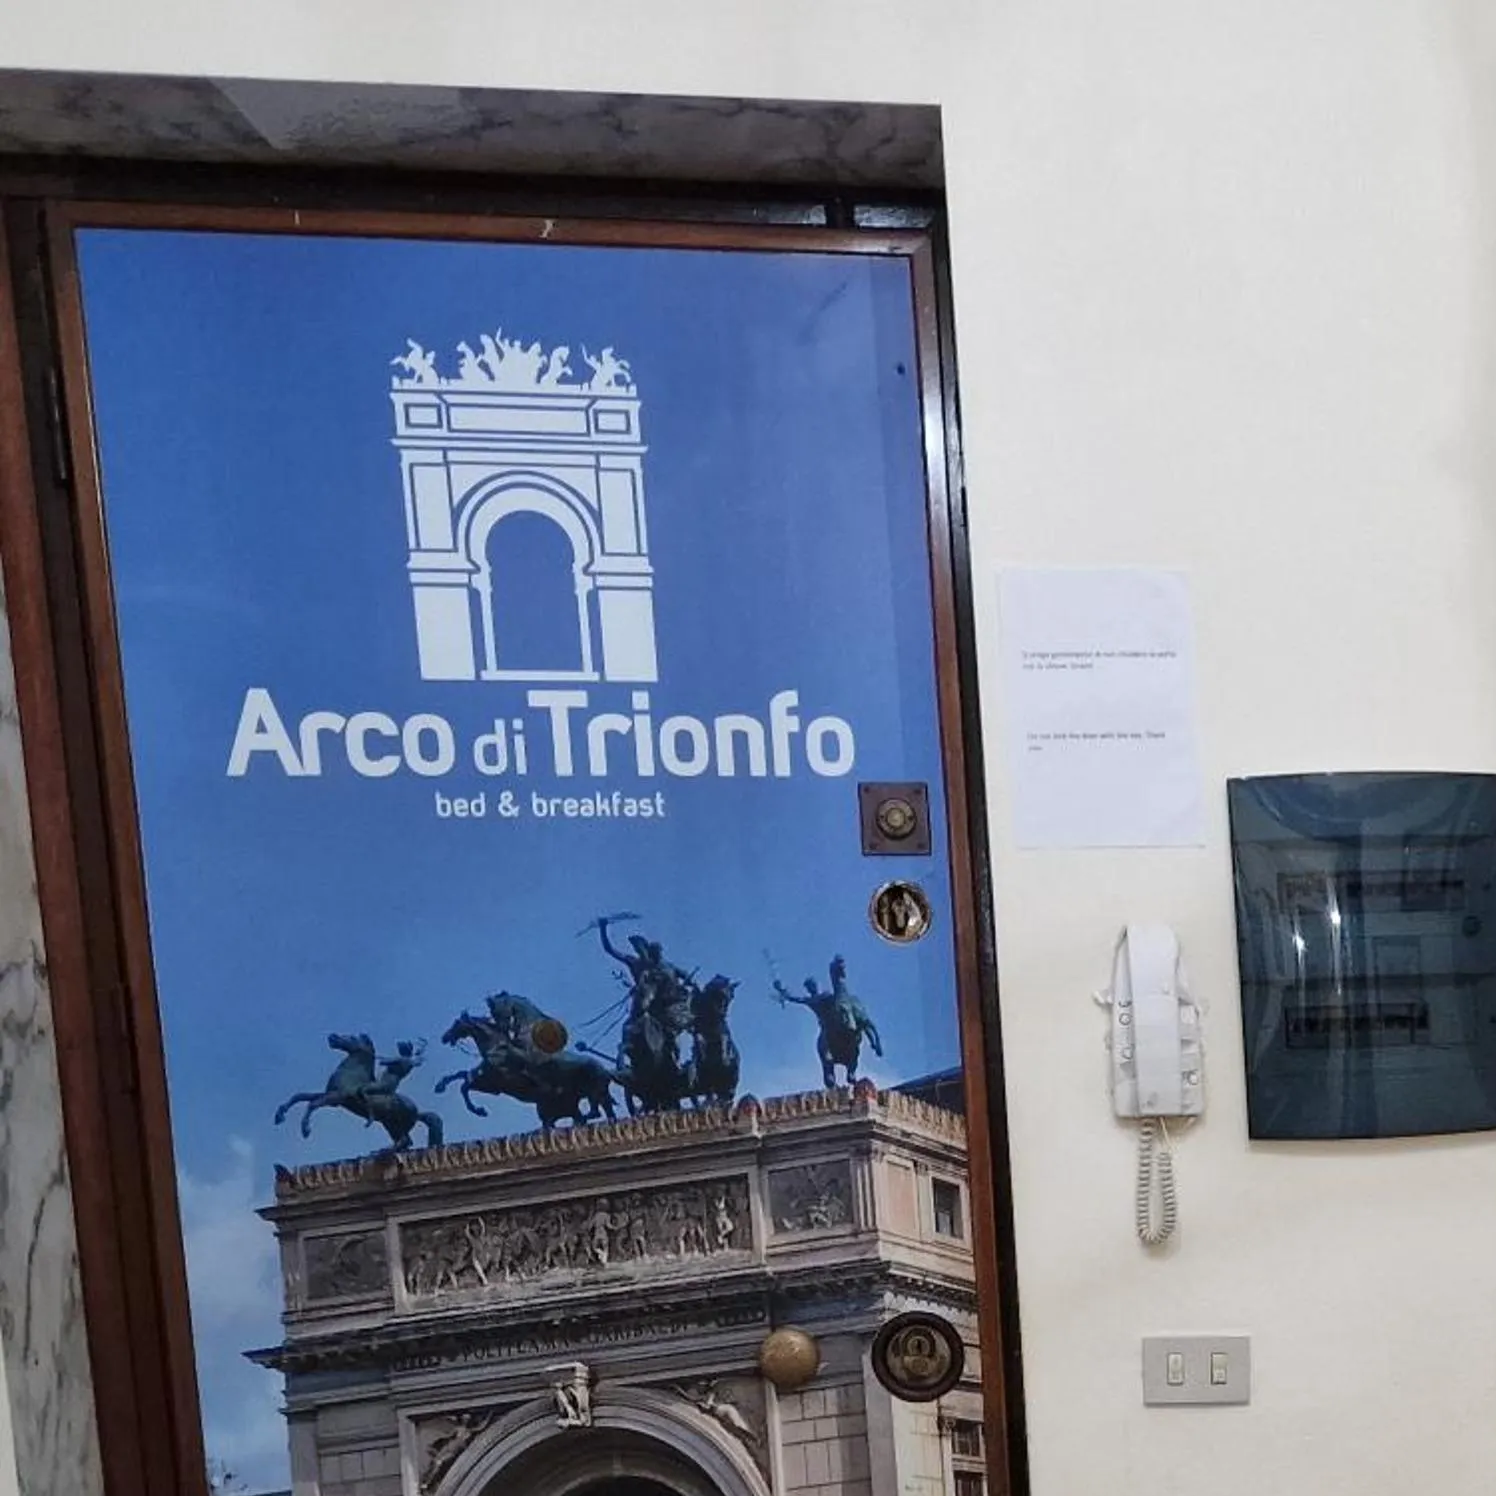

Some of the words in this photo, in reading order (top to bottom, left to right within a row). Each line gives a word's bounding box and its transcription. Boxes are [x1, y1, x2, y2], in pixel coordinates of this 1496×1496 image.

[226, 687, 456, 777] Arco
[473, 718, 527, 776] di
[527, 689, 855, 777] Trionfo
[435, 791, 486, 818] bed
[497, 790, 520, 817] &
[531, 791, 665, 818] breakfast
